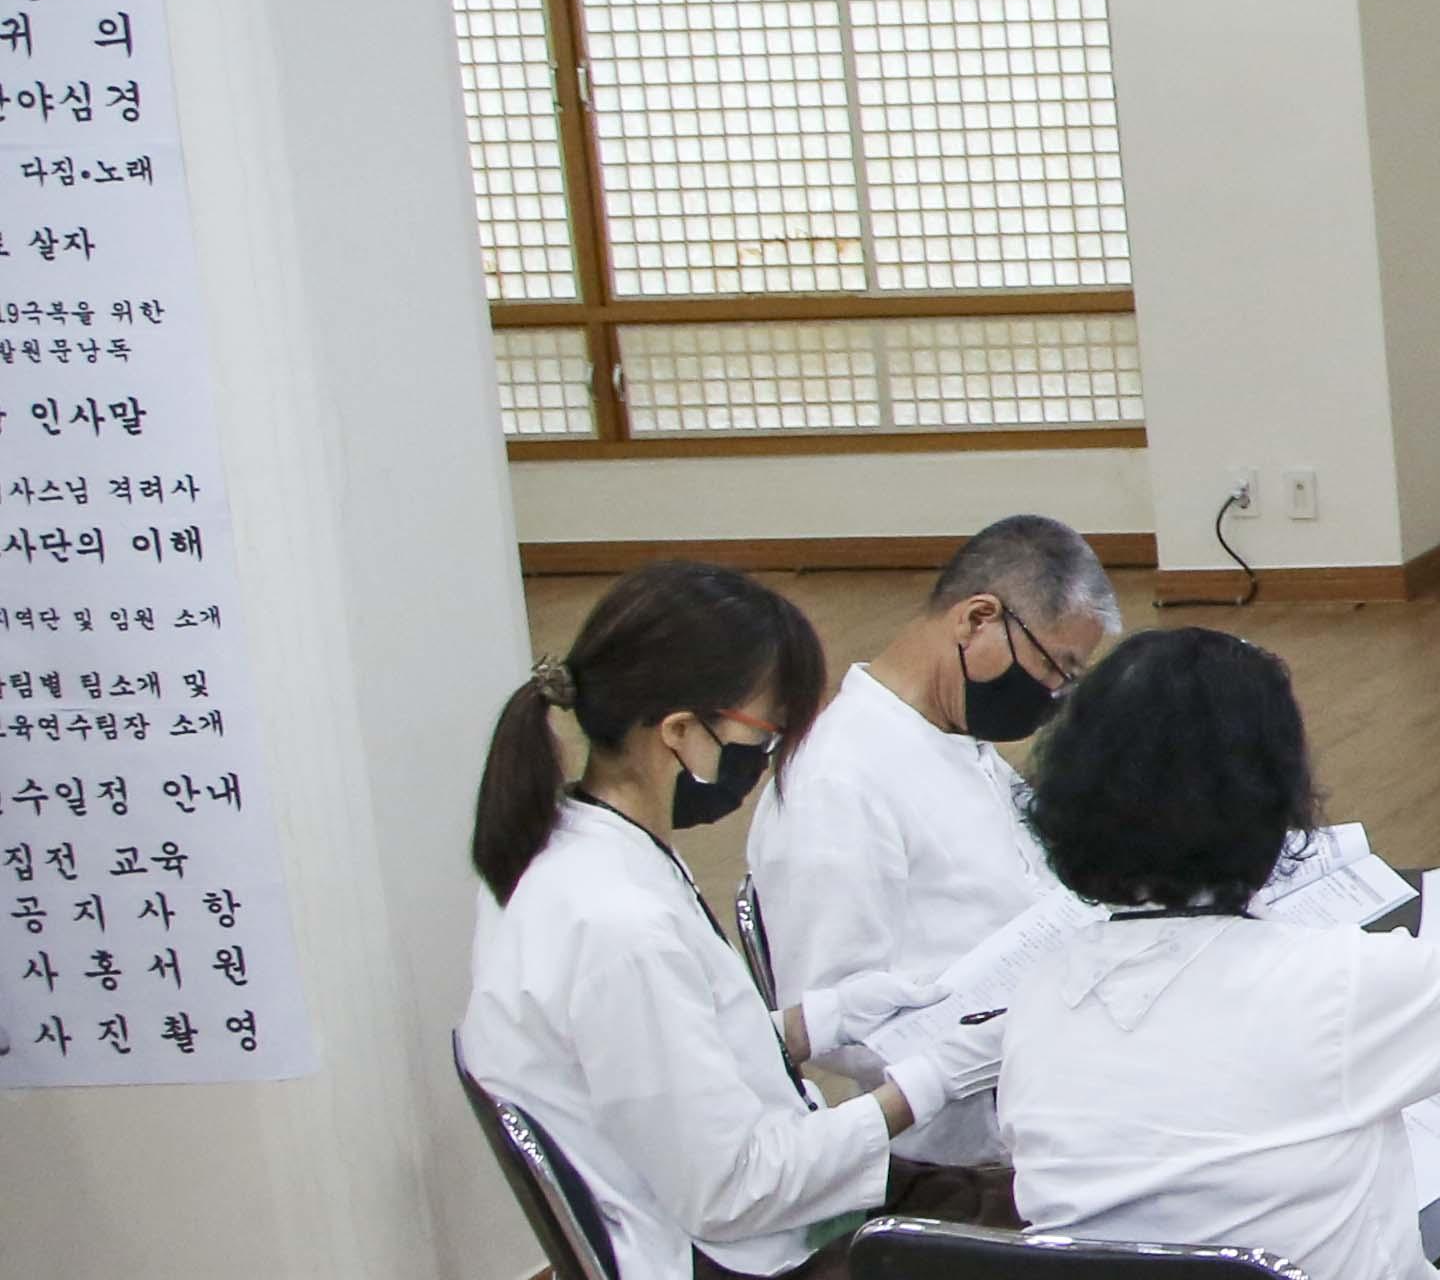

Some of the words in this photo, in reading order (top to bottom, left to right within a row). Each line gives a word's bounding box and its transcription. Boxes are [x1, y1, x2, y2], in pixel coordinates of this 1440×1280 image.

[28, 226, 96, 261] 살자
[110, 299, 165, 325] 위한
[31, 396, 147, 437] 인사말
[0, 476, 89, 505] 사스님
[109, 474, 201, 505] 격려사
[0, 527, 105, 564] 사단의
[132, 525, 204, 564] 이해
[73, 607, 94, 632] 및
[110, 607, 155, 632] 임원
[174, 604, 222, 629] 소개
[183, 669, 210, 699] 및
[169, 709, 225, 737] 소개
[0, 775, 129, 817] 수일정
[163, 772, 242, 813] 안내
[109, 840, 189, 879] 교육
